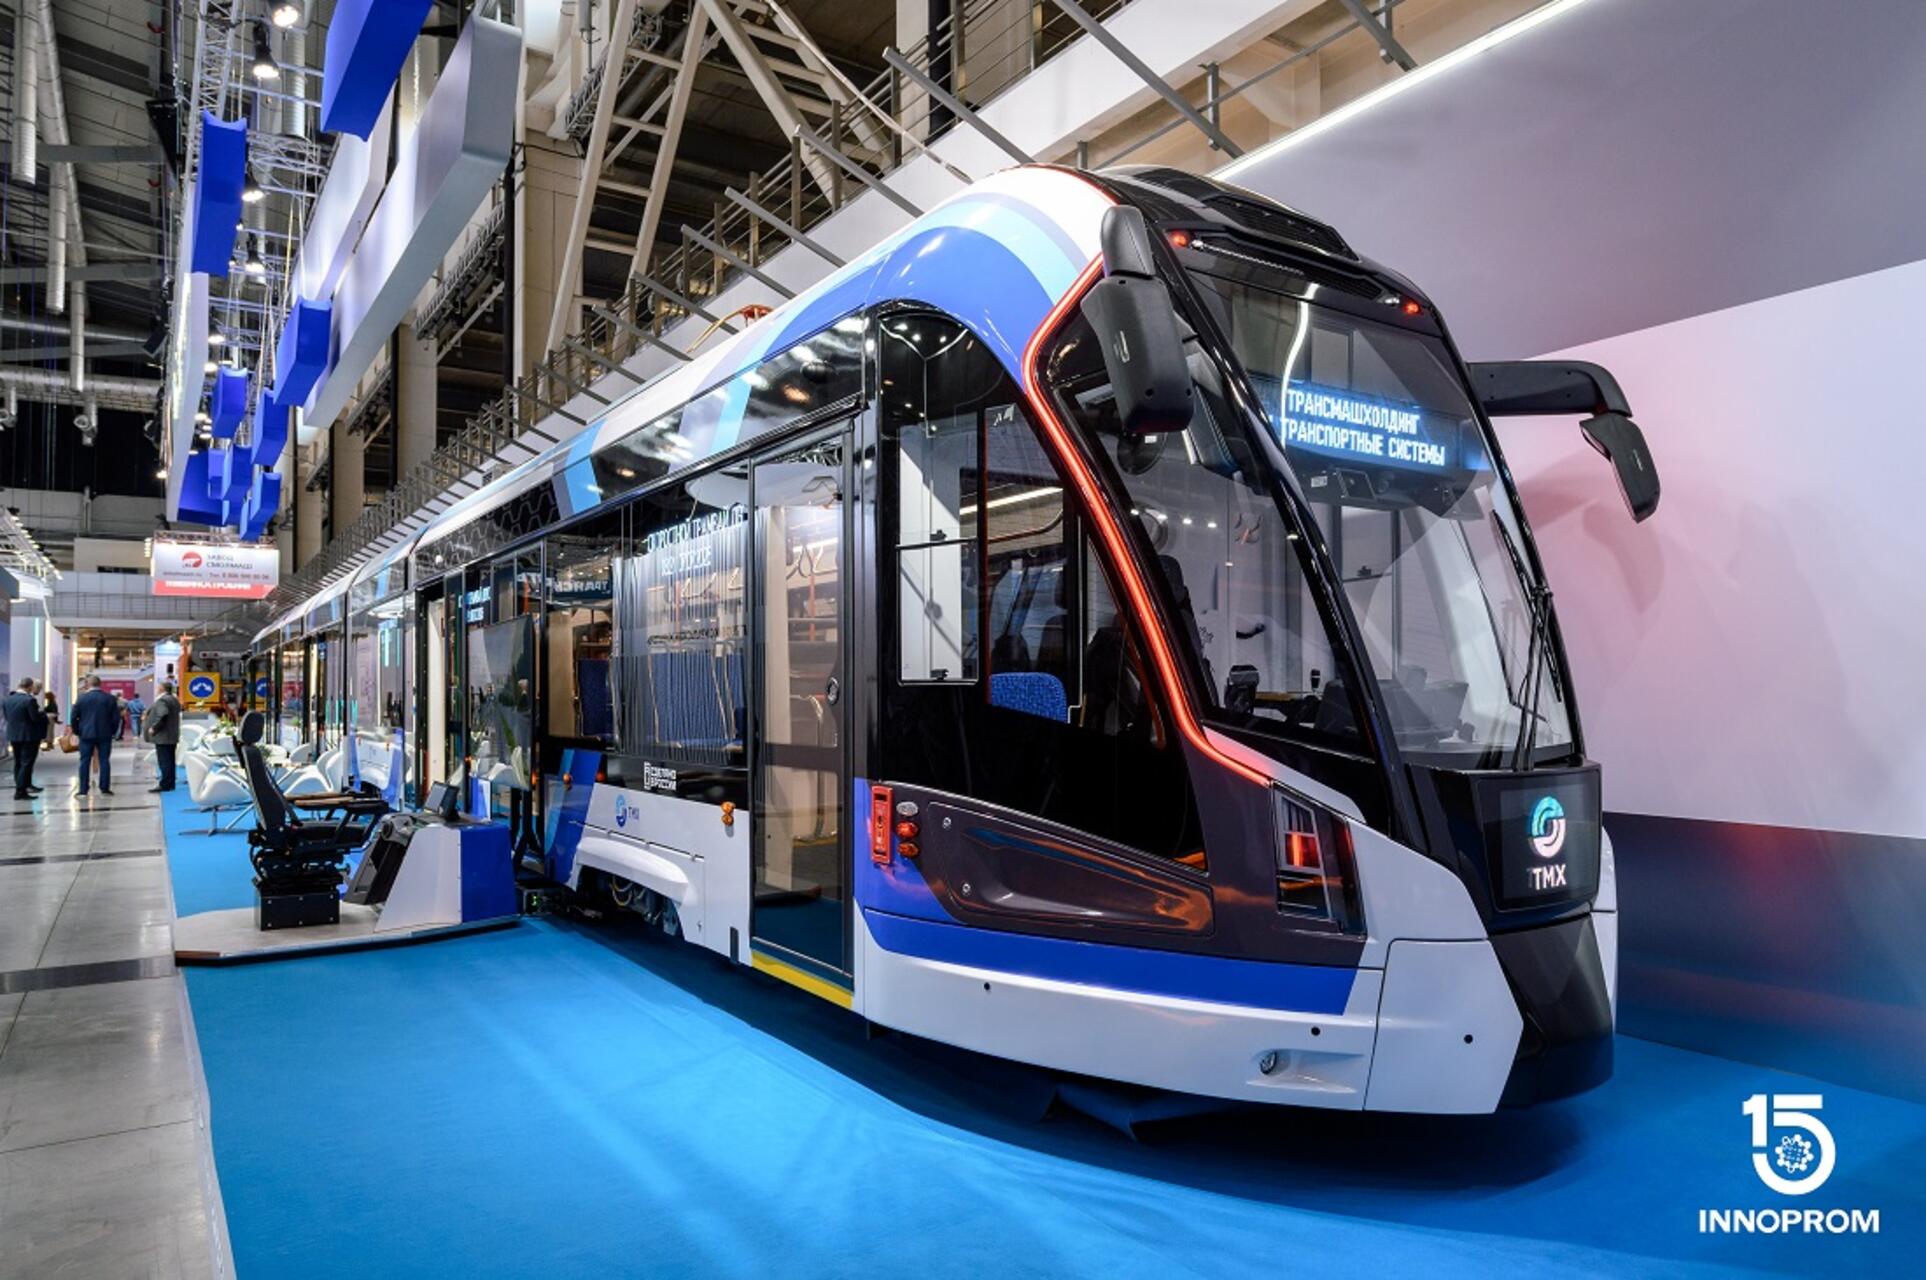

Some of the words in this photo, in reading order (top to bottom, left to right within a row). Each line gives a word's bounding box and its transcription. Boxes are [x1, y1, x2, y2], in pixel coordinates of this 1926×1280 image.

[1287, 389, 1421, 434] ТРАНСМАШХОЛДИНГ
[1281, 418, 1384, 456] ТРАНСПОРТНЫЕ
[1388, 437, 1446, 466] СИСТЕМЫ
